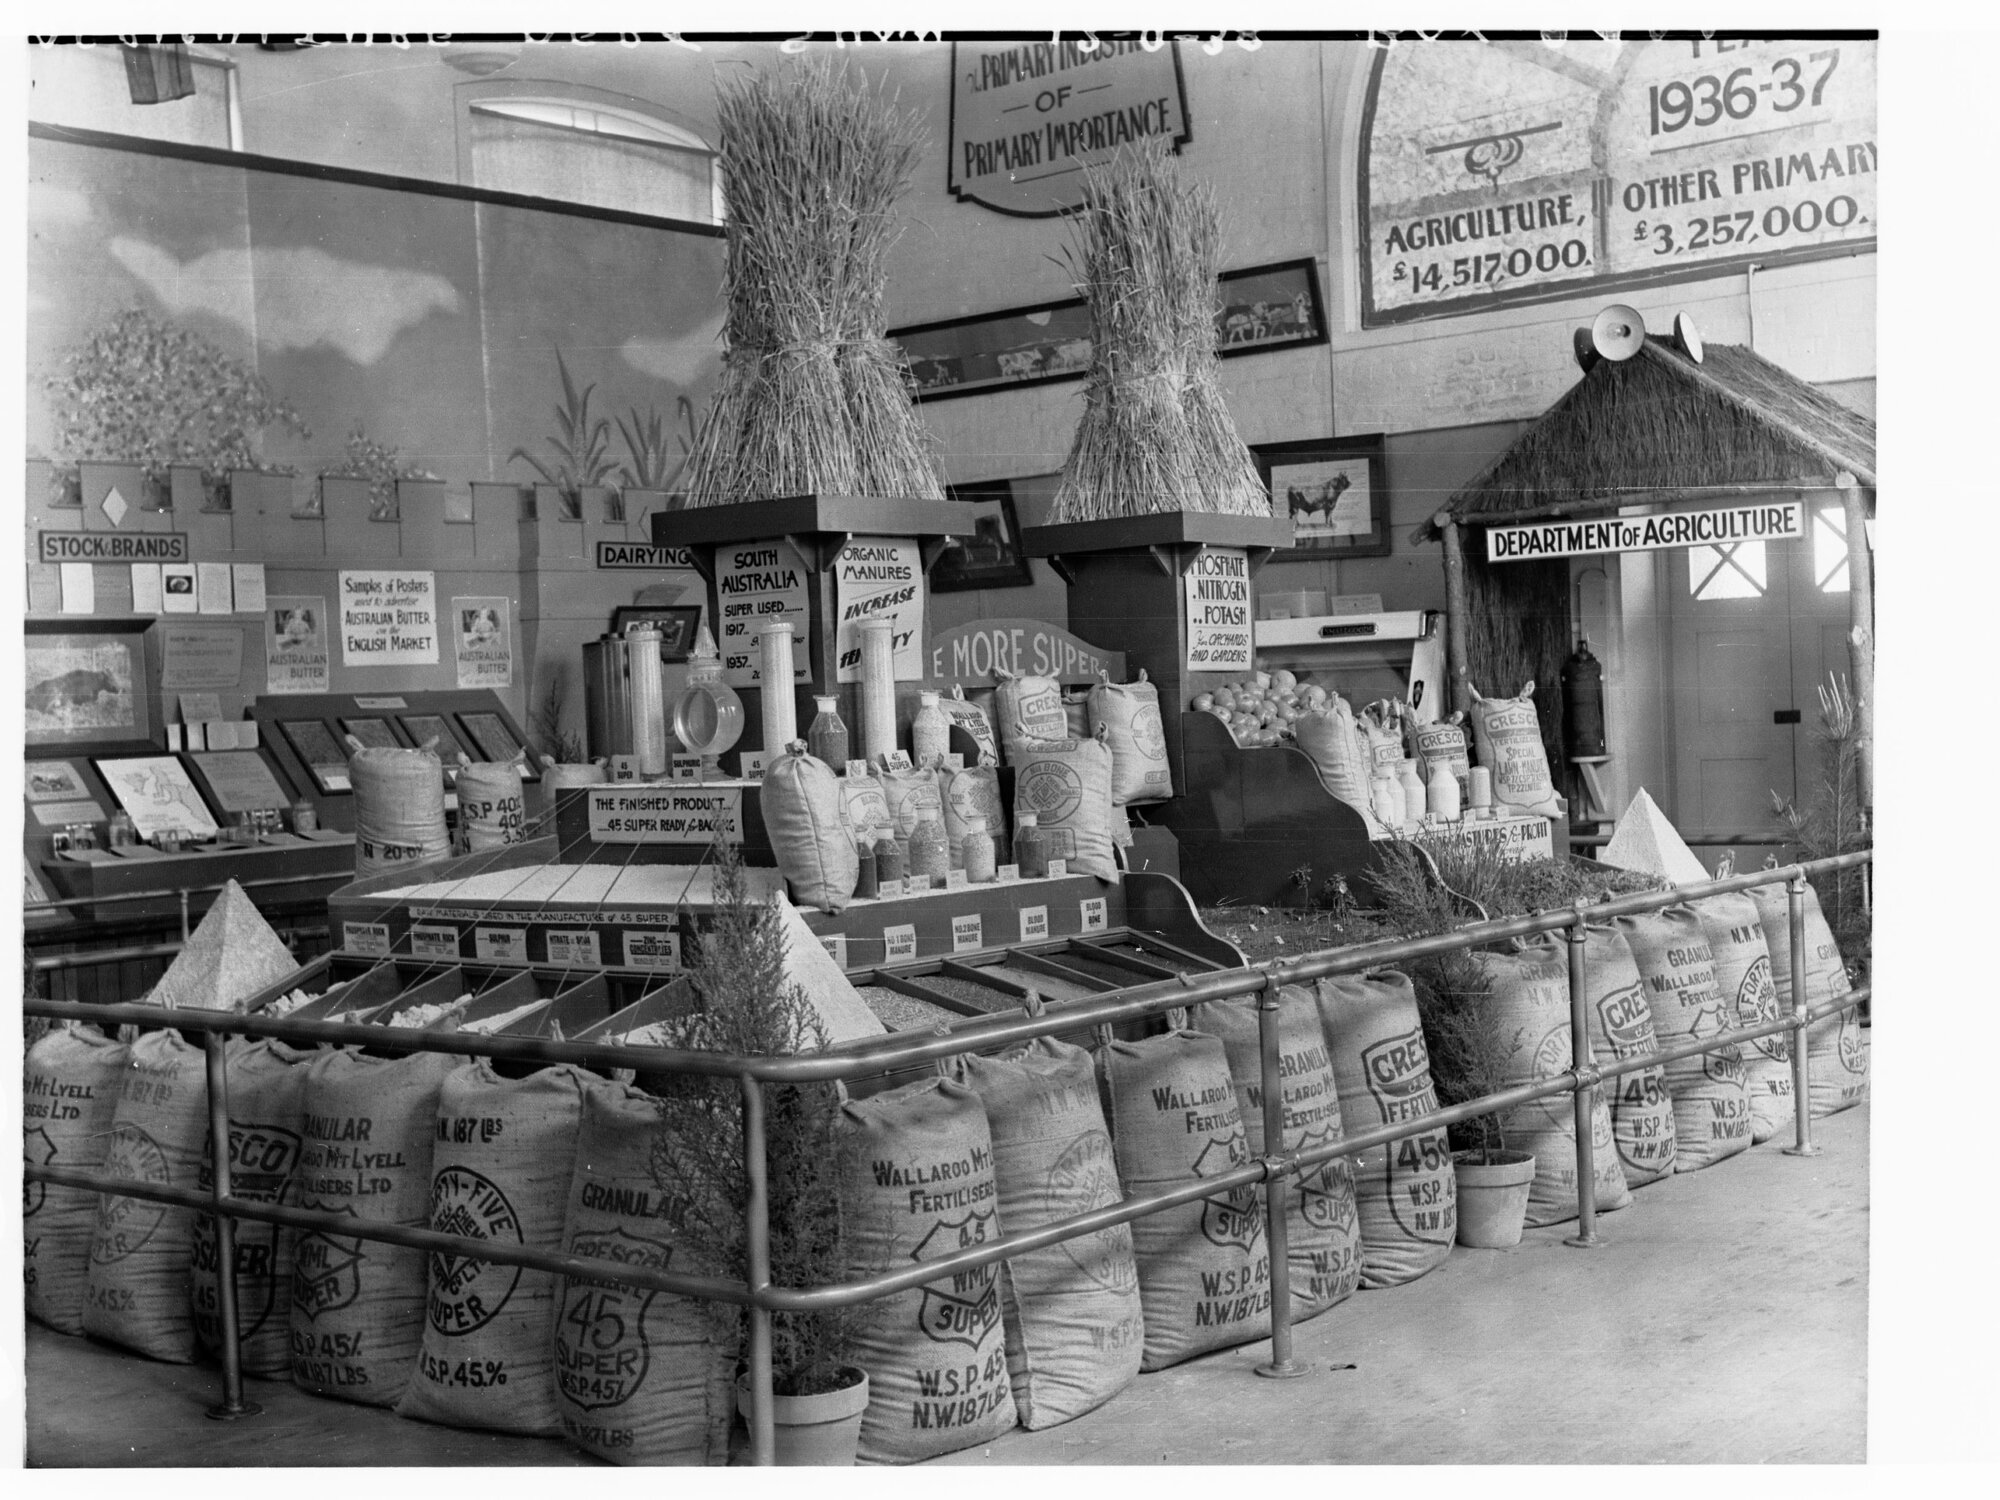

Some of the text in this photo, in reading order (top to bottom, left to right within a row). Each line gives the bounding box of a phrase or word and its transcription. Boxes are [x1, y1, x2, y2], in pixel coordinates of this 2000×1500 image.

[981, 42, 1053, 91] PRIMARY
[1035, 85, 1072, 113] OF
[1649, 48, 1840, 136] 1936-37
[964, 129, 1043, 179] PRIMARY
[1623, 141, 1877, 213] OTHER PRIMARY
[1494, 506, 1797, 557] DEPARTMENT OF AGRICULTURE
[46, 537, 104, 557] STOCK
[112, 538, 182, 558] BRANDS
[604, 547, 691, 564] DAIRYING
[841, 547, 899, 562] ORGANIC
[735, 549, 778, 569] SOUTH
[721, 570, 799, 594] AUSTRALIA
[843, 565, 912, 580] MANURES
[345, 577, 429, 594] Samples of Posters
[724, 603, 753, 617] SUPER
[844, 585, 916, 621] INCREASE
[345, 610, 431, 626] AUSTRALIAN BUTTER
[348, 636, 432, 652] ENGLISH MARKET
[953, 629, 1026, 677] MORE
[1033, 632, 1101, 677] SUPER
[269, 654, 327, 666] AUSTRALIAN
[458, 651, 511, 662] AUSTRALIAN
[1190, 649, 1207, 663] AND
[290, 667, 325, 679] BUTTER
[477, 663, 508, 674] BUTTER
[1489, 713, 1538, 730] CRESCO
[1421, 732, 1463, 748] CRESCO
[889, 761, 911, 771] SUPER
[891, 752, 901, 760] 45
[617, 771, 633, 780] SUPER
[595, 798, 615, 811] THE
[619, 798, 669, 811] FINISHED
[624, 819, 657, 832] SUPER
[660, 819, 686, 832] READY
[436, 910, 479, 919] MATERIALS
[535, 912, 604, 921] MANUFACTURE
[621, 914, 632, 922] 45
[636, 914, 668, 923] SUPER
[50, 1077, 95, 1099] LYELL
[1152, 1084, 1227, 1112] WALLAROO
[51, 1099, 81, 1120] LTD
[352, 1148, 407, 1169] LYELL
[872, 1157, 971, 1187] WALLAROO
[357, 1173, 393, 1195] LTD
[909, 1180, 994, 1215] FERTILISERS
[959, 1221, 987, 1249] 45
[567, 1291, 625, 1350] 45
[934, 1288, 999, 1337] SUPER
[558, 1337, 639, 1377] SUPER
